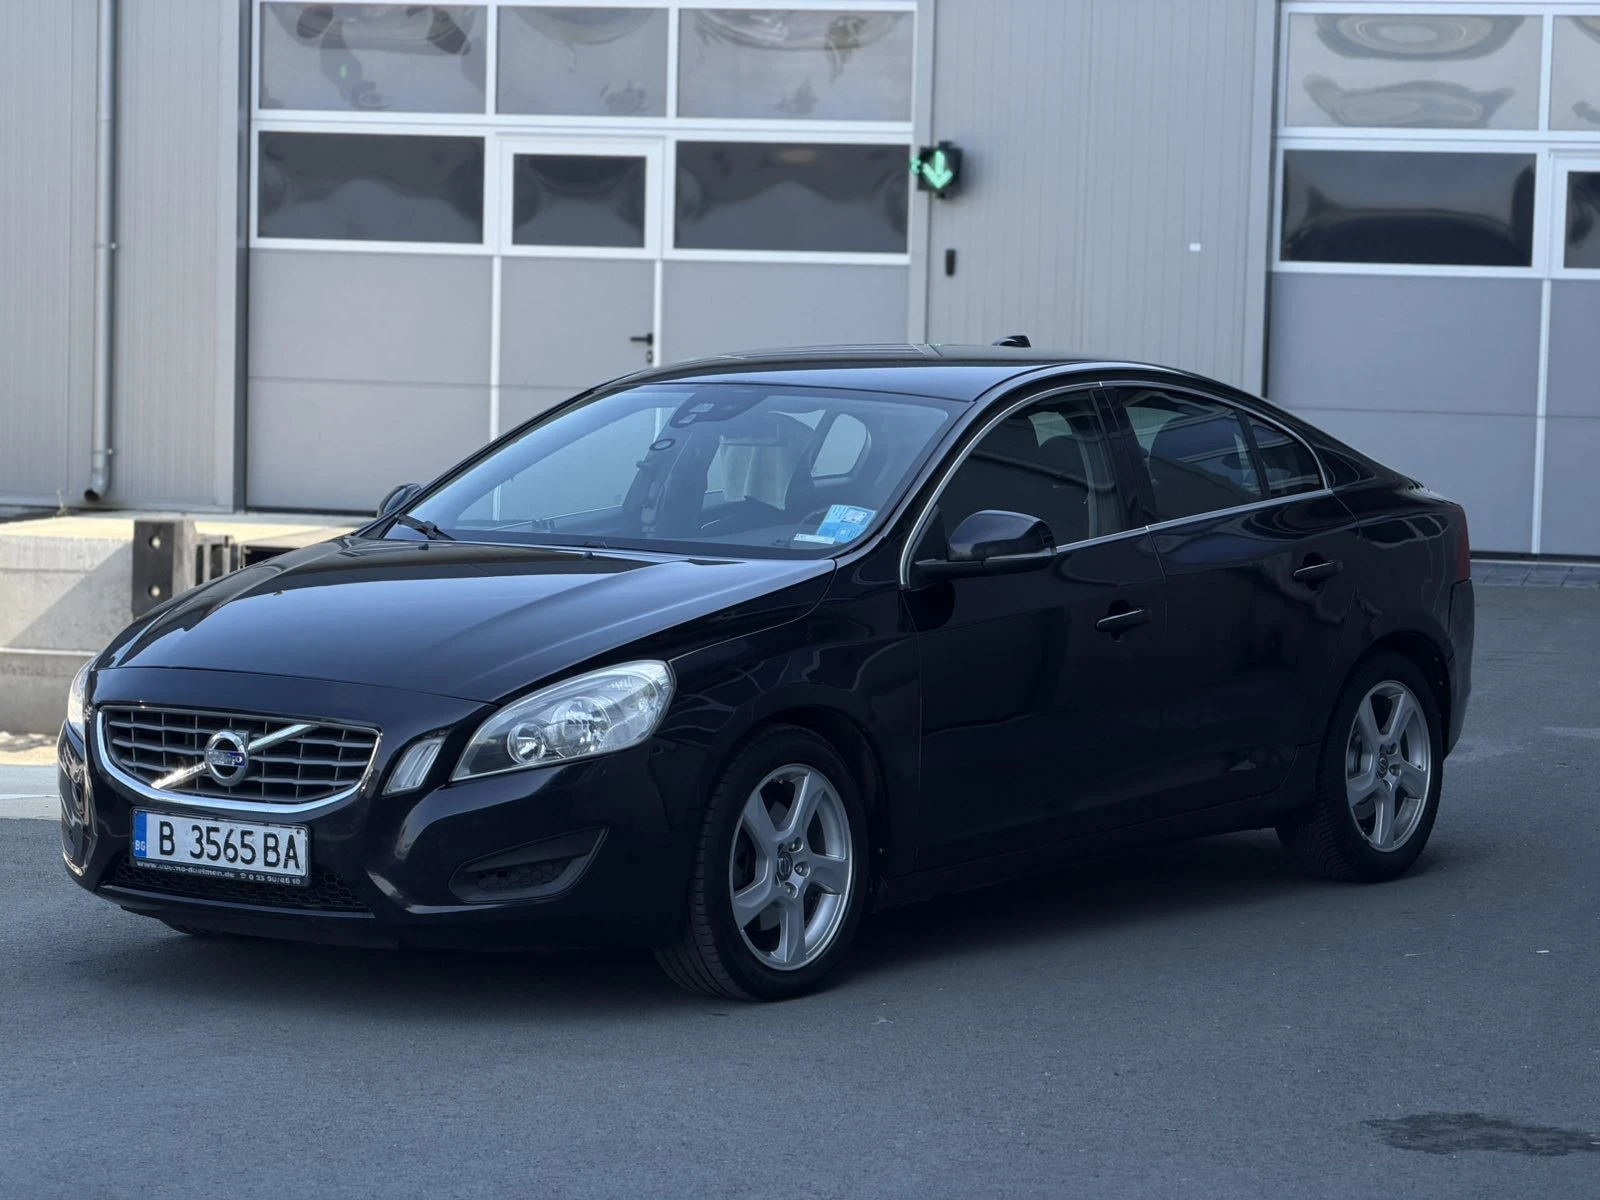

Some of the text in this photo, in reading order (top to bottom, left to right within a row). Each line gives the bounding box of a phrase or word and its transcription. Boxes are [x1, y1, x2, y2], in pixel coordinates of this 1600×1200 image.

[135, 840, 146, 851] BG
[159, 820, 300, 869] B 3565 BA
